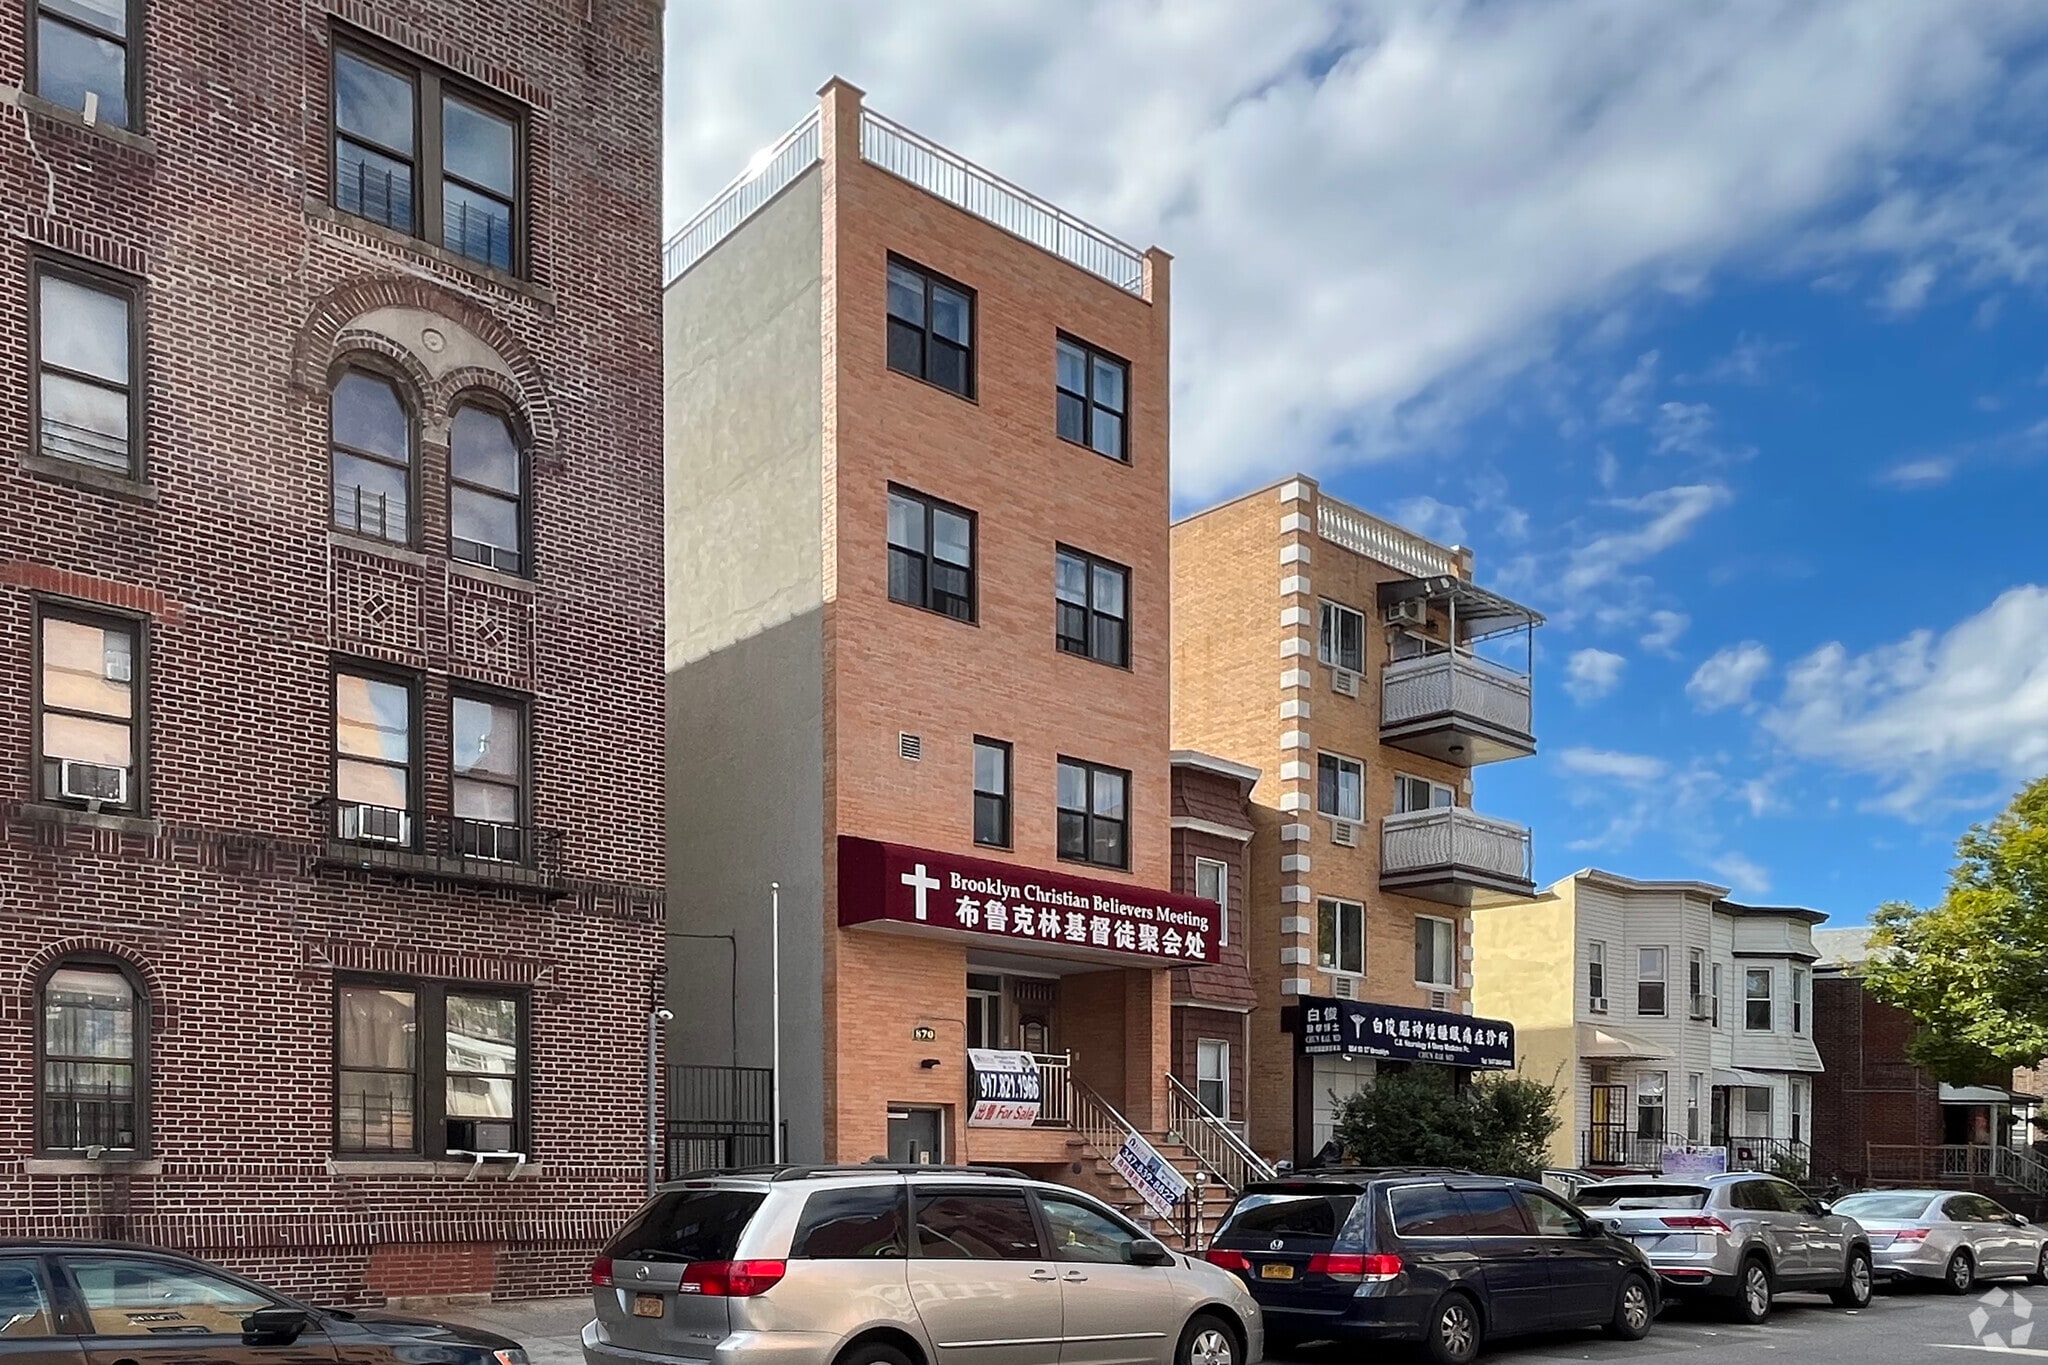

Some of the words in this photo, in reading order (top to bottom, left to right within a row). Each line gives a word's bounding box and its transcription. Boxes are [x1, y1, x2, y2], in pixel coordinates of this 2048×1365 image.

[950, 871, 1020, 900] Brooklyn
[1024, 883, 1090, 910] Christian
[1093, 895, 1153, 920] Believers
[1156, 906, 1209, 932] Meeting
[955, 894, 1207, 960] 布鲁克林基督徒聚会处
[996, 1105, 1013, 1119] For
[1013, 1105, 1034, 1120] Sale
[1121, 1148, 1175, 1203] 347-839-8822
